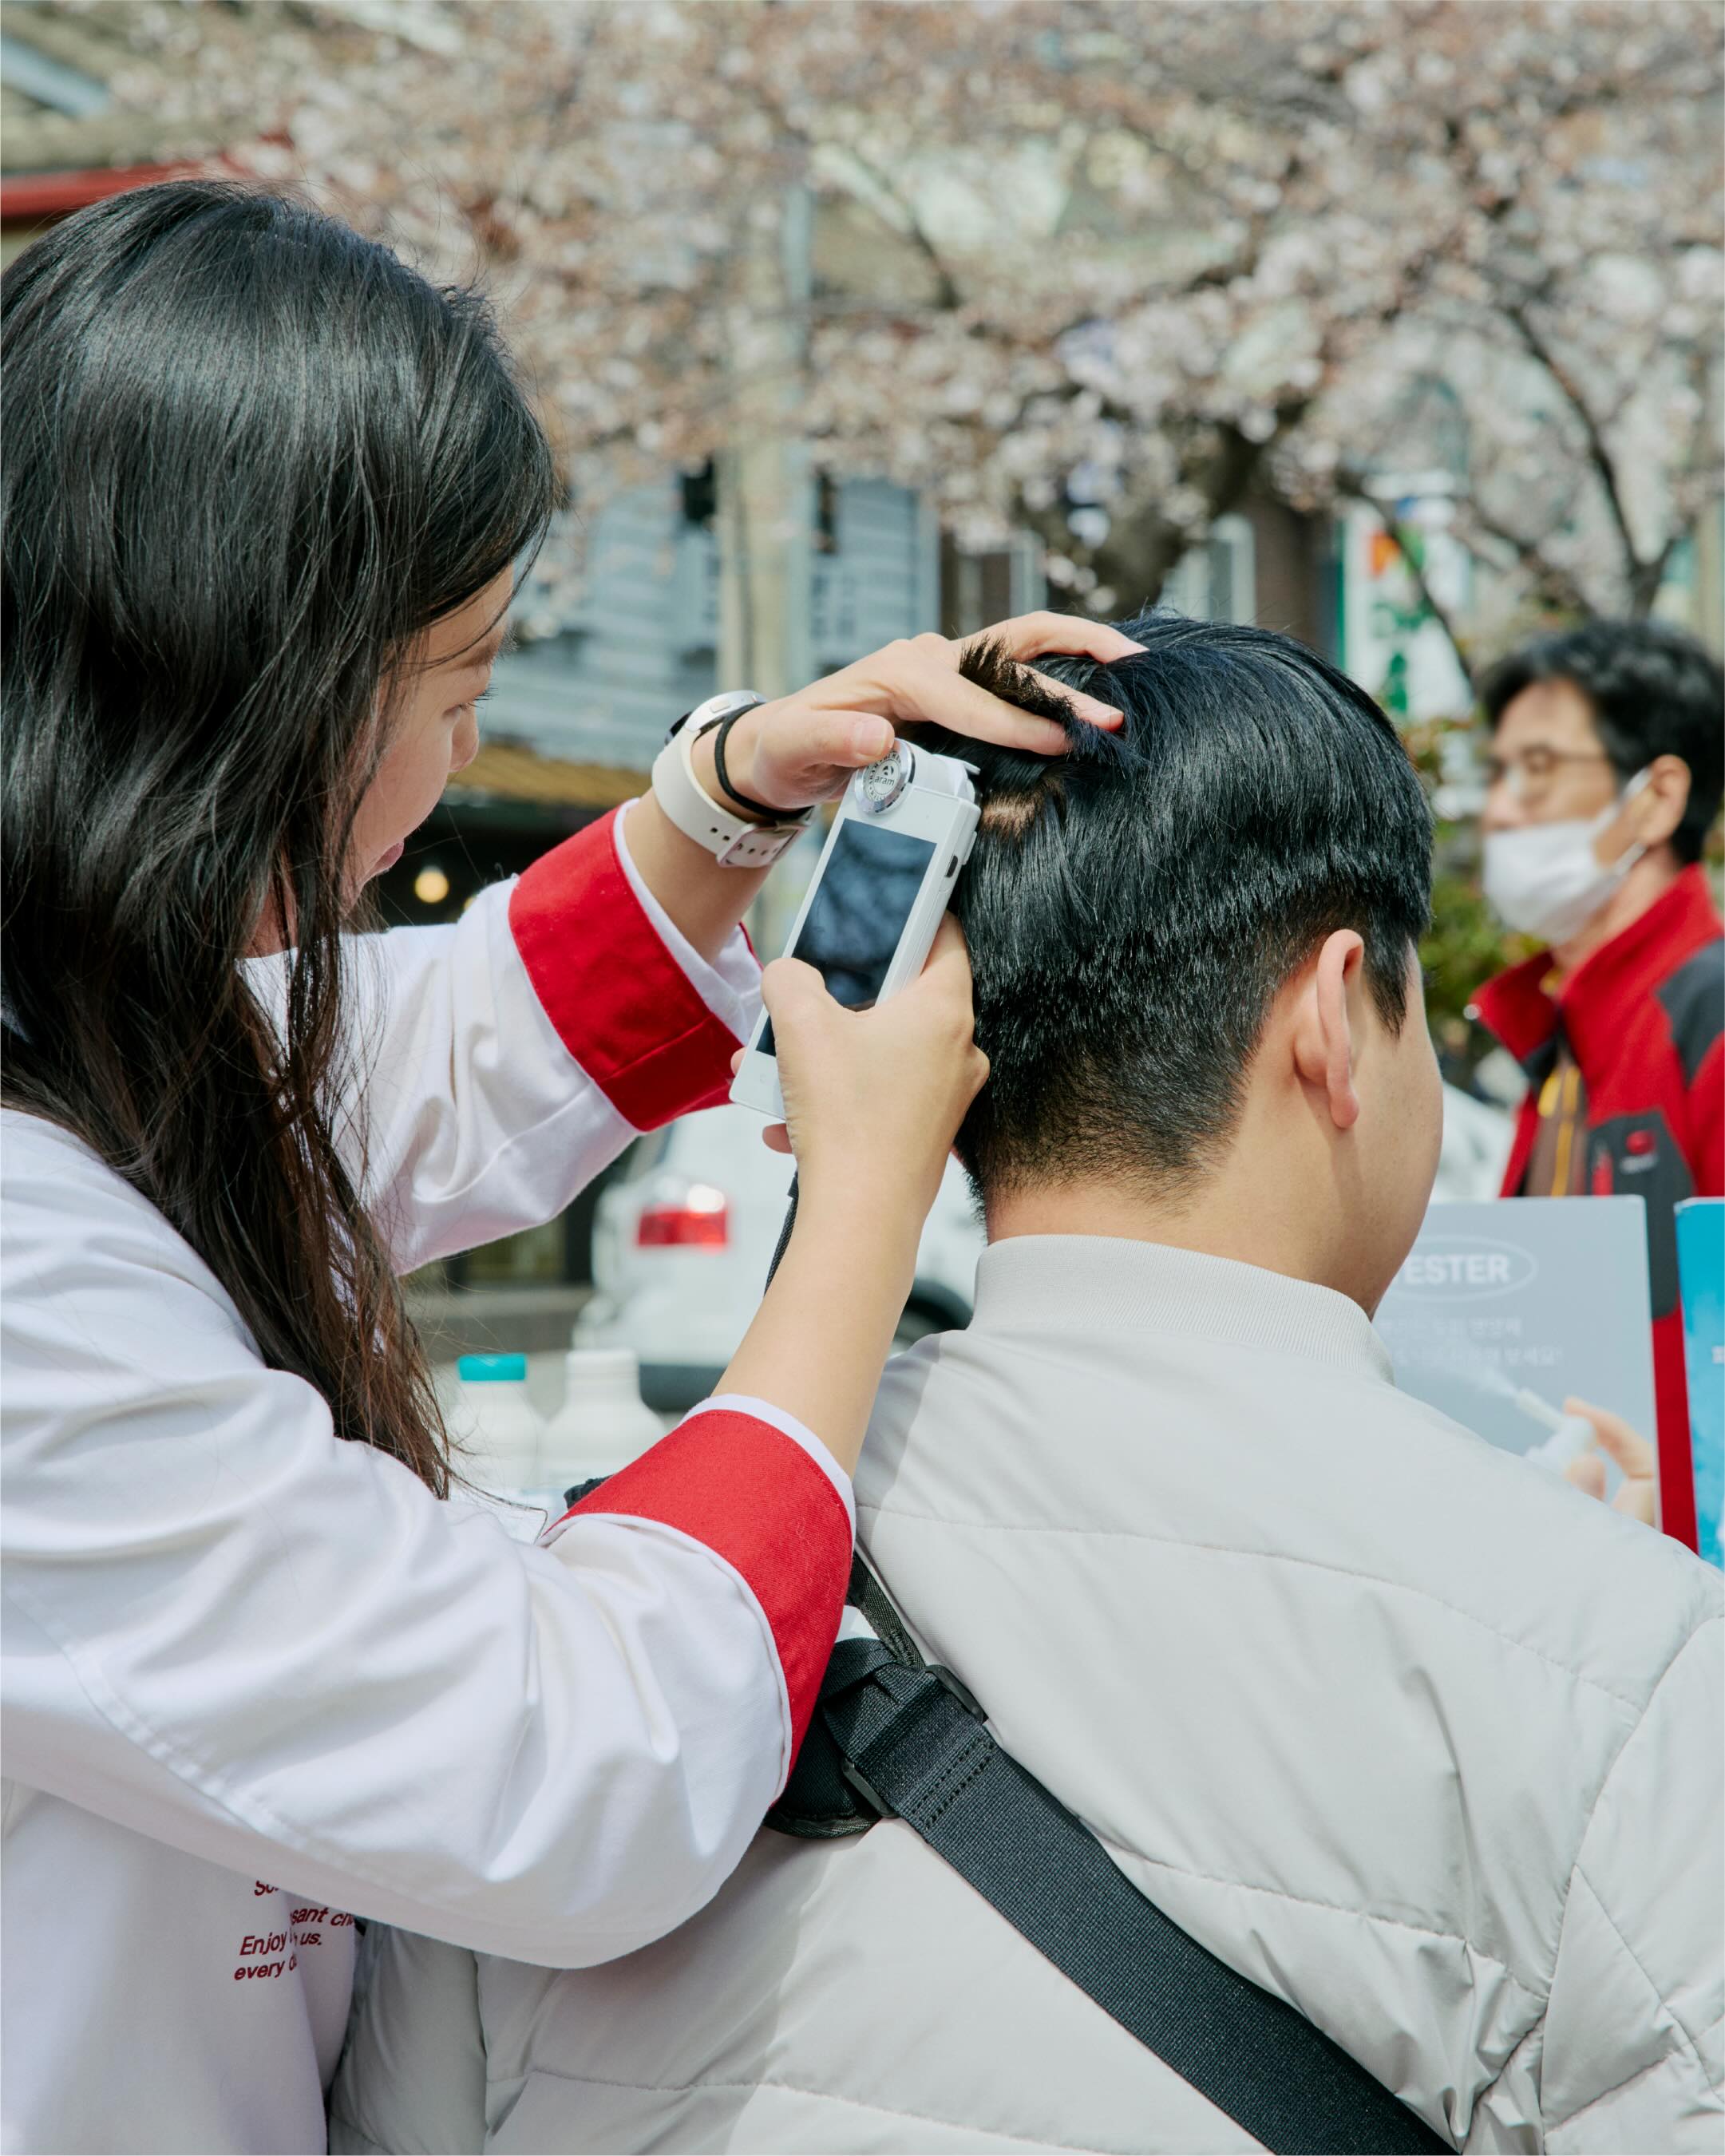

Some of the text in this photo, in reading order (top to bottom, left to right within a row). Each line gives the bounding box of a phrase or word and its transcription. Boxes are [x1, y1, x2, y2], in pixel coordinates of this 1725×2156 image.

[875, 776, 894, 786] aram
[1392, 1252, 1510, 1285] ESTER
[239, 1930, 287, 1956] Enjoy
[290, 1907, 328, 1925] sant
[234, 1960, 285, 1980] every
[300, 1932, 322, 1945] us.
